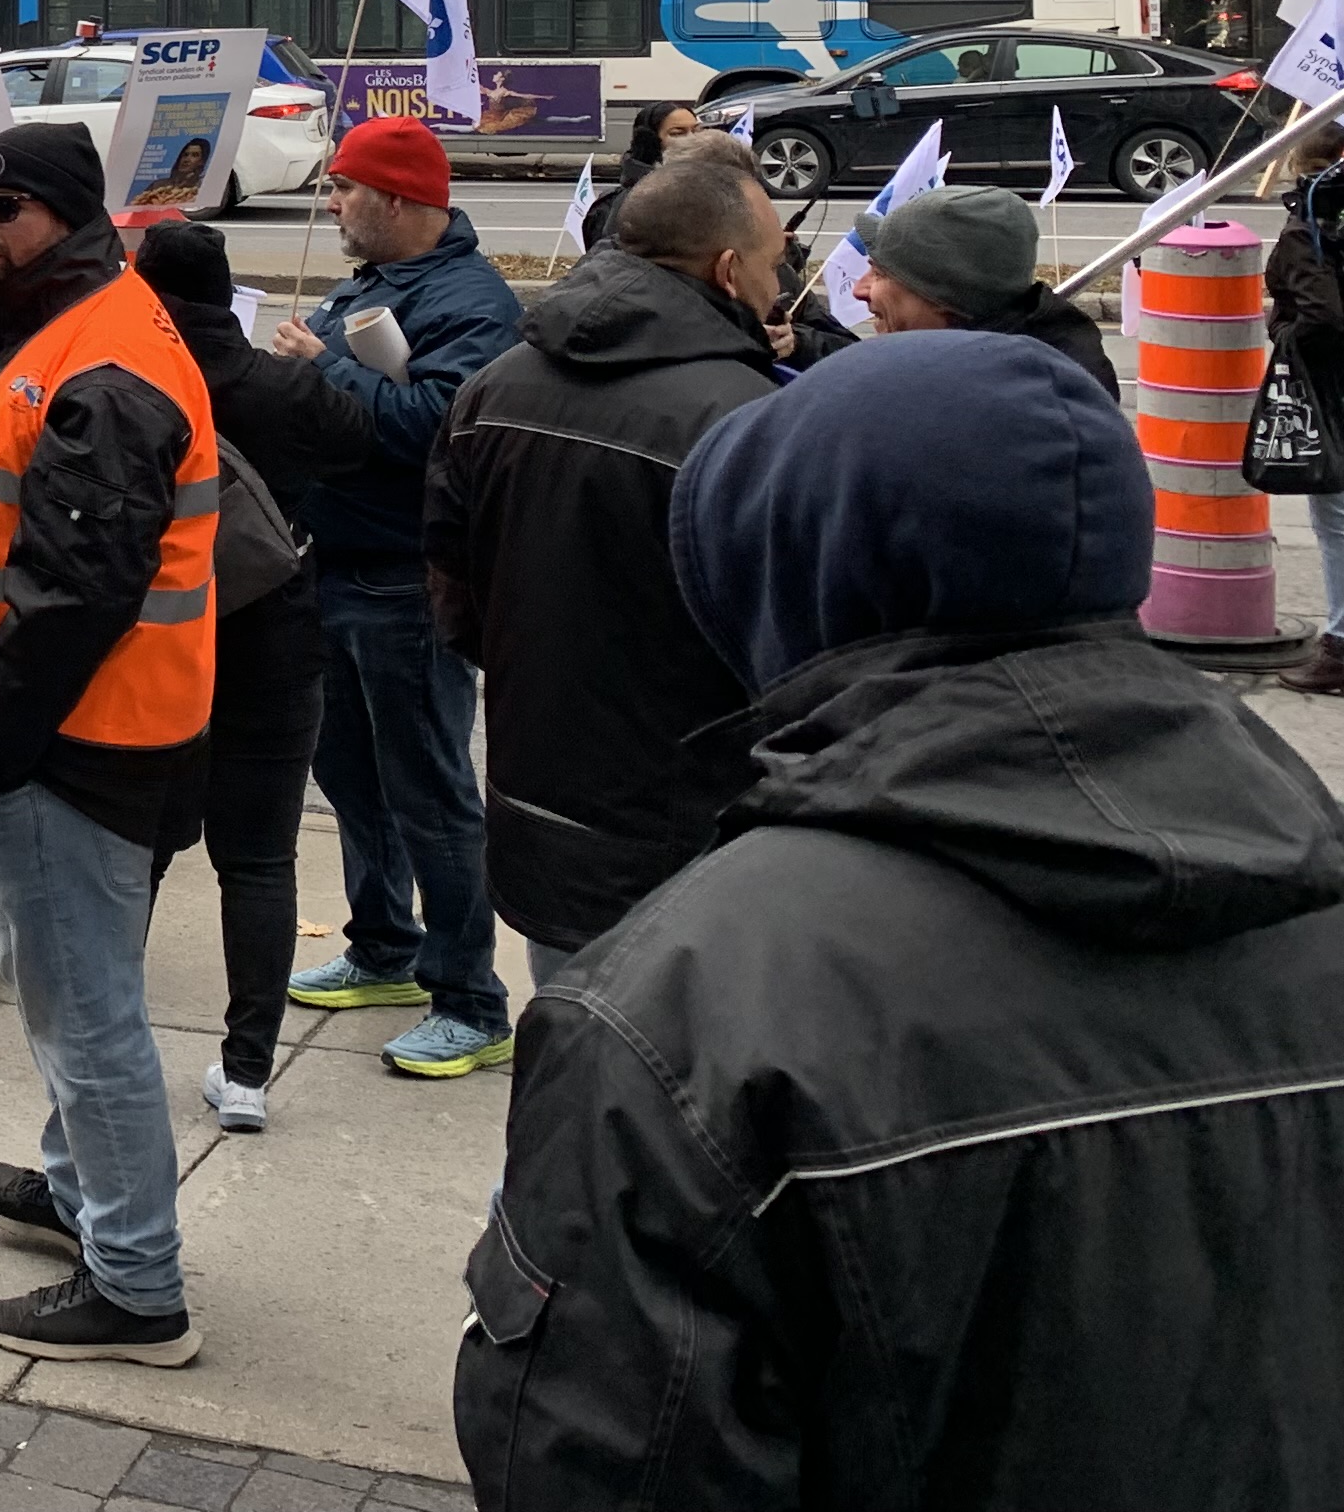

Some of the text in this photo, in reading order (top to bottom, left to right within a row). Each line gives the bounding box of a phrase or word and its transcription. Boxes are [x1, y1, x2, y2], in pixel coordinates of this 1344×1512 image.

[141, 39, 220, 64] SCFP
[1297, 59, 1311, 72] la
[138, 68, 165, 76] Syndicat
[375, 69, 392, 77] LES
[172, 73, 201, 81] publique
